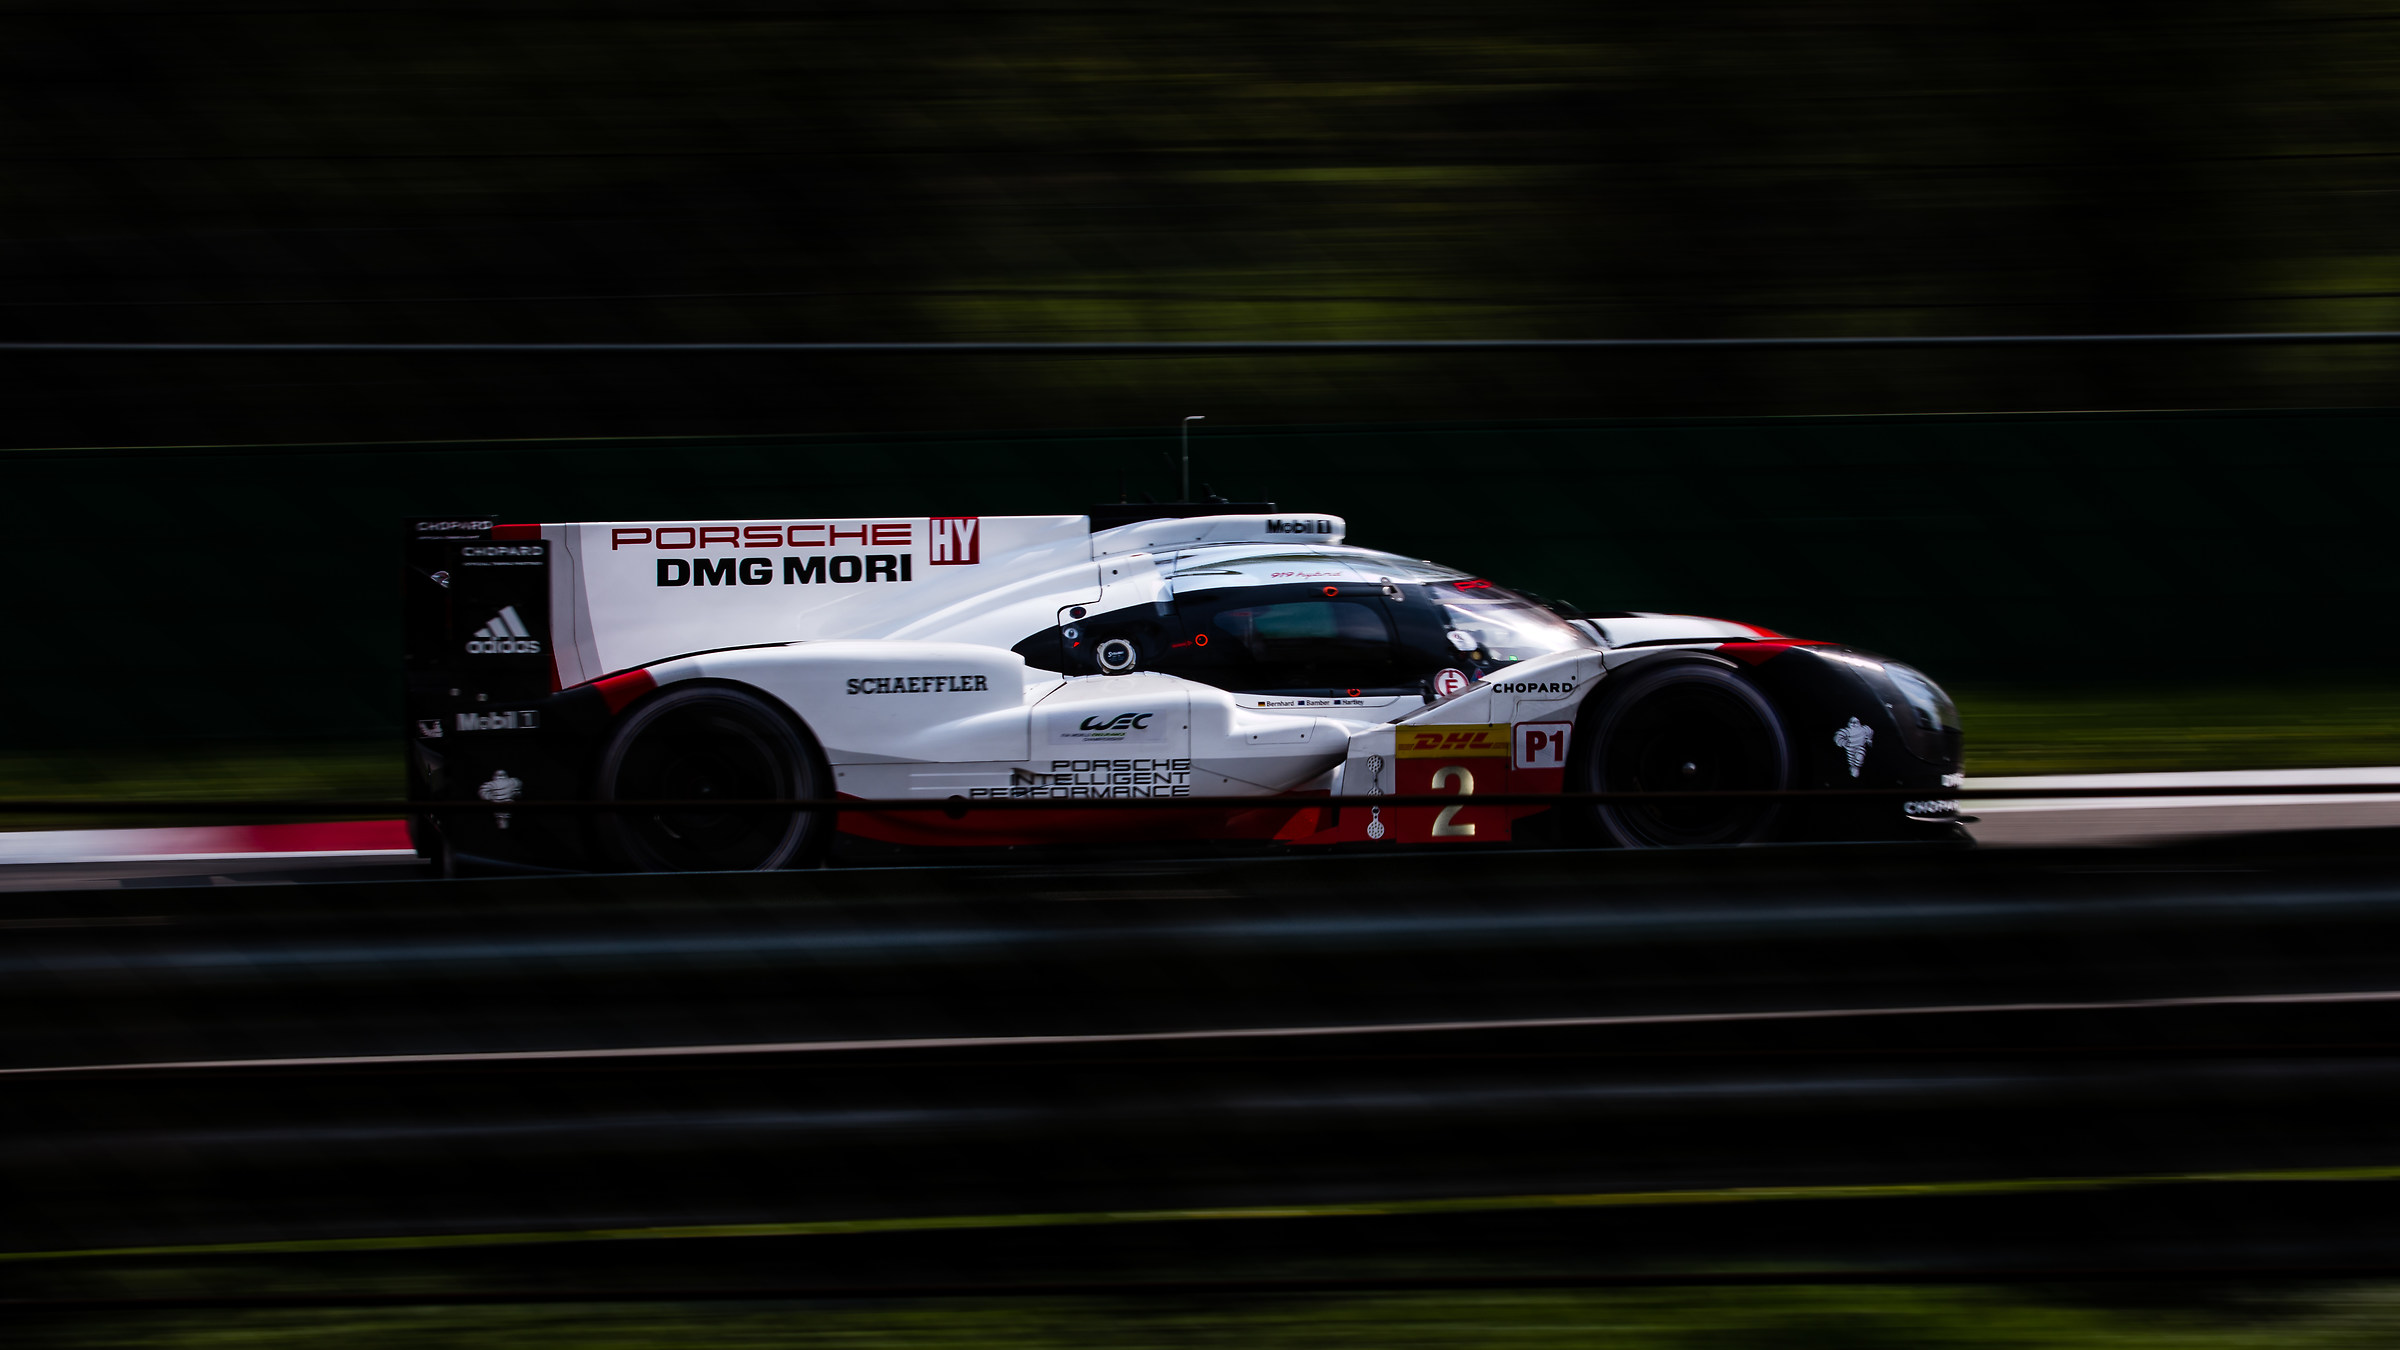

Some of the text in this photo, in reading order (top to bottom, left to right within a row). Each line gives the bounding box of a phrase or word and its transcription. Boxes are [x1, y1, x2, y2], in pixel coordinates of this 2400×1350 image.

[1266, 519, 1314, 533] Mobil
[612, 524, 912, 550] PORSCHE
[931, 519, 978, 561] HY
[460, 546, 544, 556] CHOPARD
[657, 554, 912, 587] DMG MORI
[465, 639, 542, 654] adidas
[847, 675, 988, 695] SCHAEFFLER
[1493, 682, 1573, 693] CHOPARD
[456, 711, 518, 731] Mobil
[520, 710, 539, 728] 1
[1080, 712, 1153, 730] WEC
[1413, 732, 1493, 750] DHL
[1525, 730, 1564, 762] P1
[1052, 758, 1190, 772] PORSCHE
[1011, 772, 1190, 785] INTELLIGENT
[970, 785, 1190, 798] PERFORMANCE
[1431, 765, 1476, 837] 2
